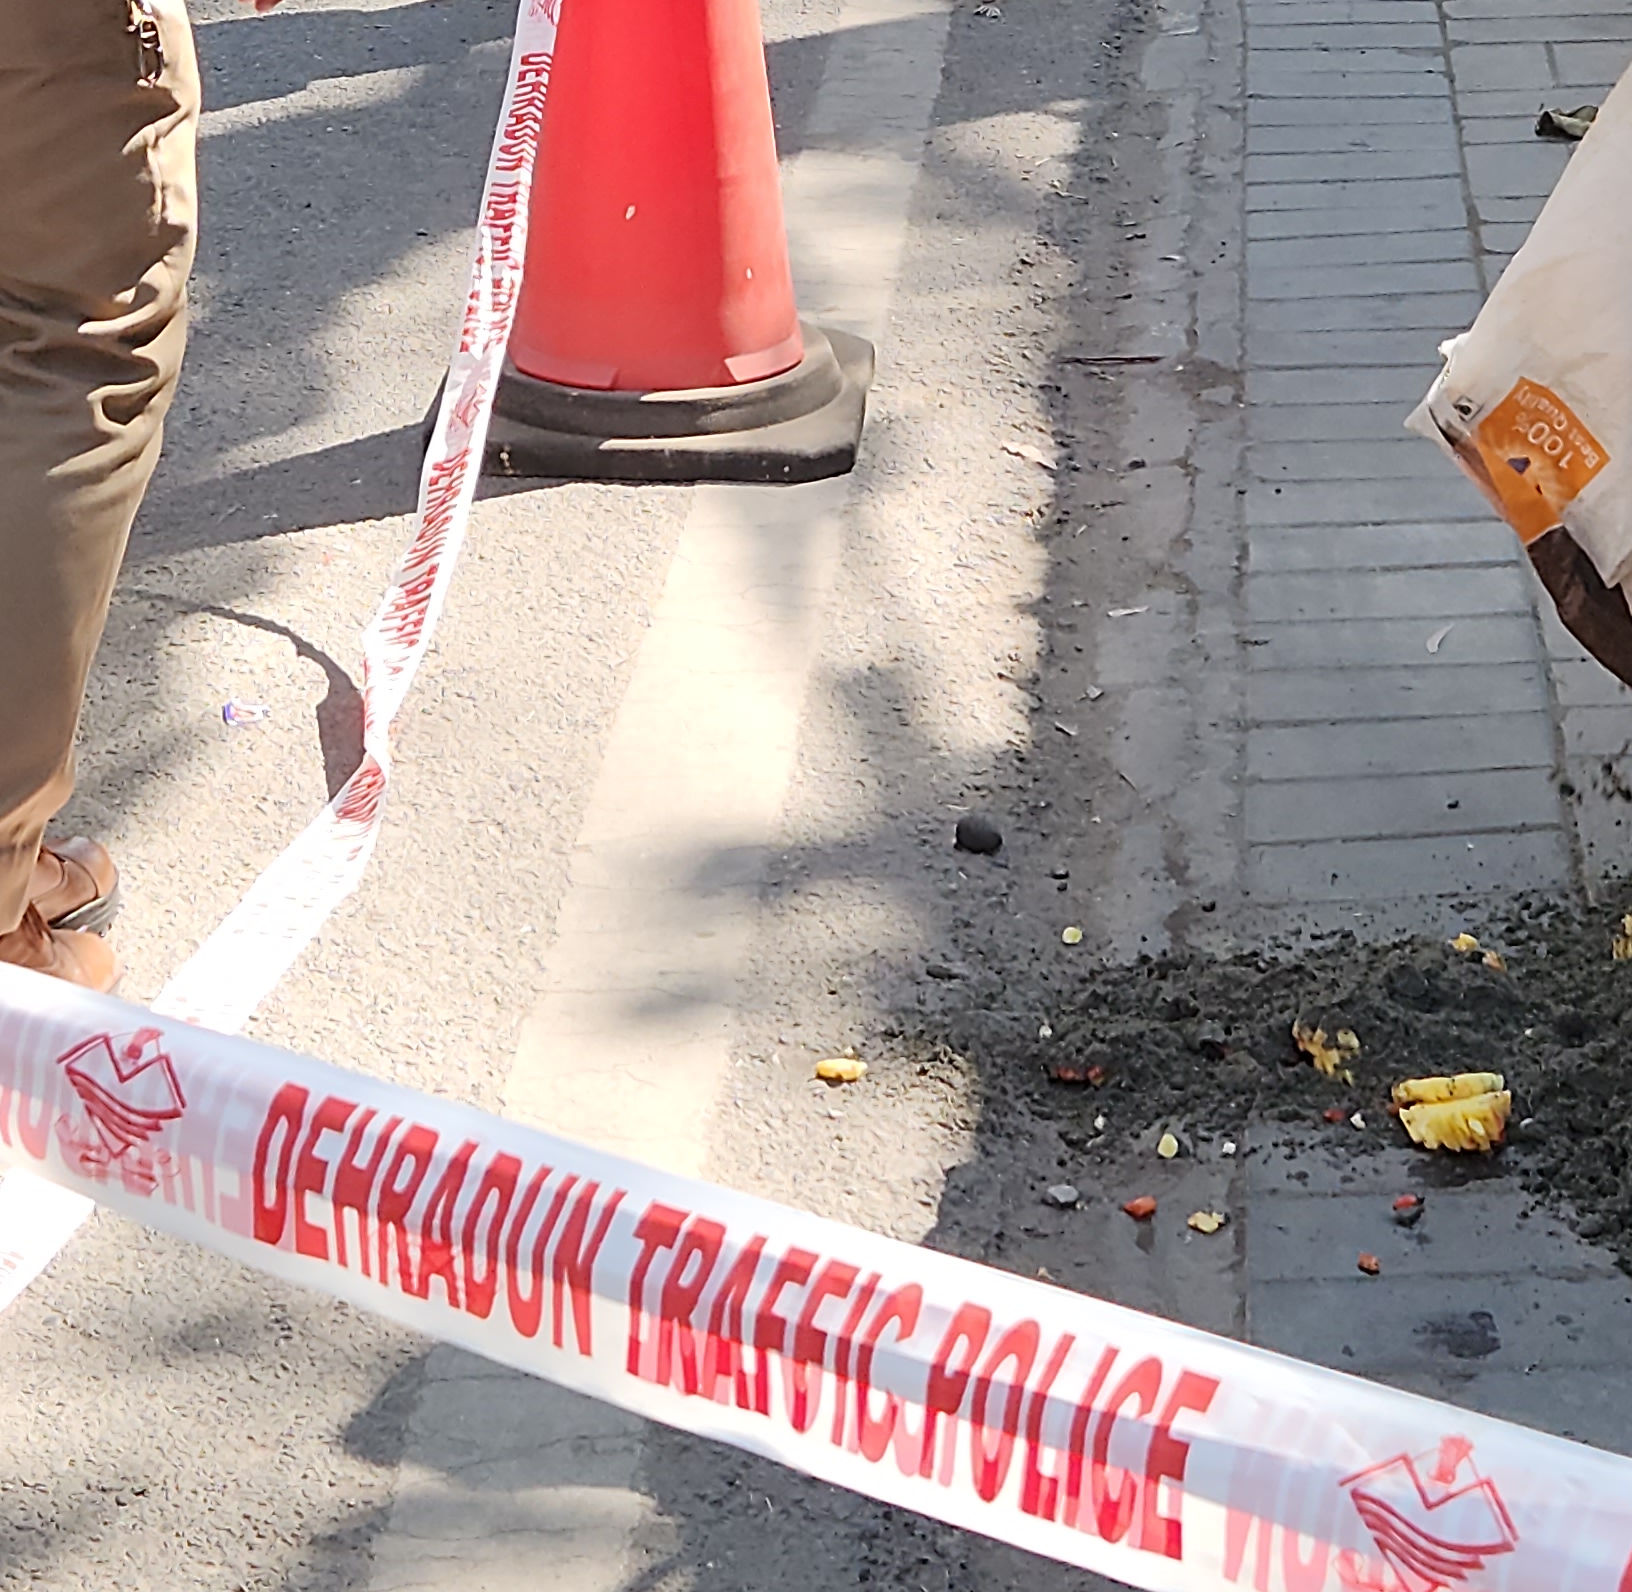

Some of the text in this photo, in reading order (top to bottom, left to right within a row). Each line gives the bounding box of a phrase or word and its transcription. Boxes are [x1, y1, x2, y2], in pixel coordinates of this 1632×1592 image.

[1514, 409, 1573, 471] 100%
[1569, 430, 1600, 471] Best
[252, 1081, 628, 1358] DEHRADUN
[625, 1199, 924, 1465] TRAFFIC
[918, 1300, 1221, 1560] POLICE
